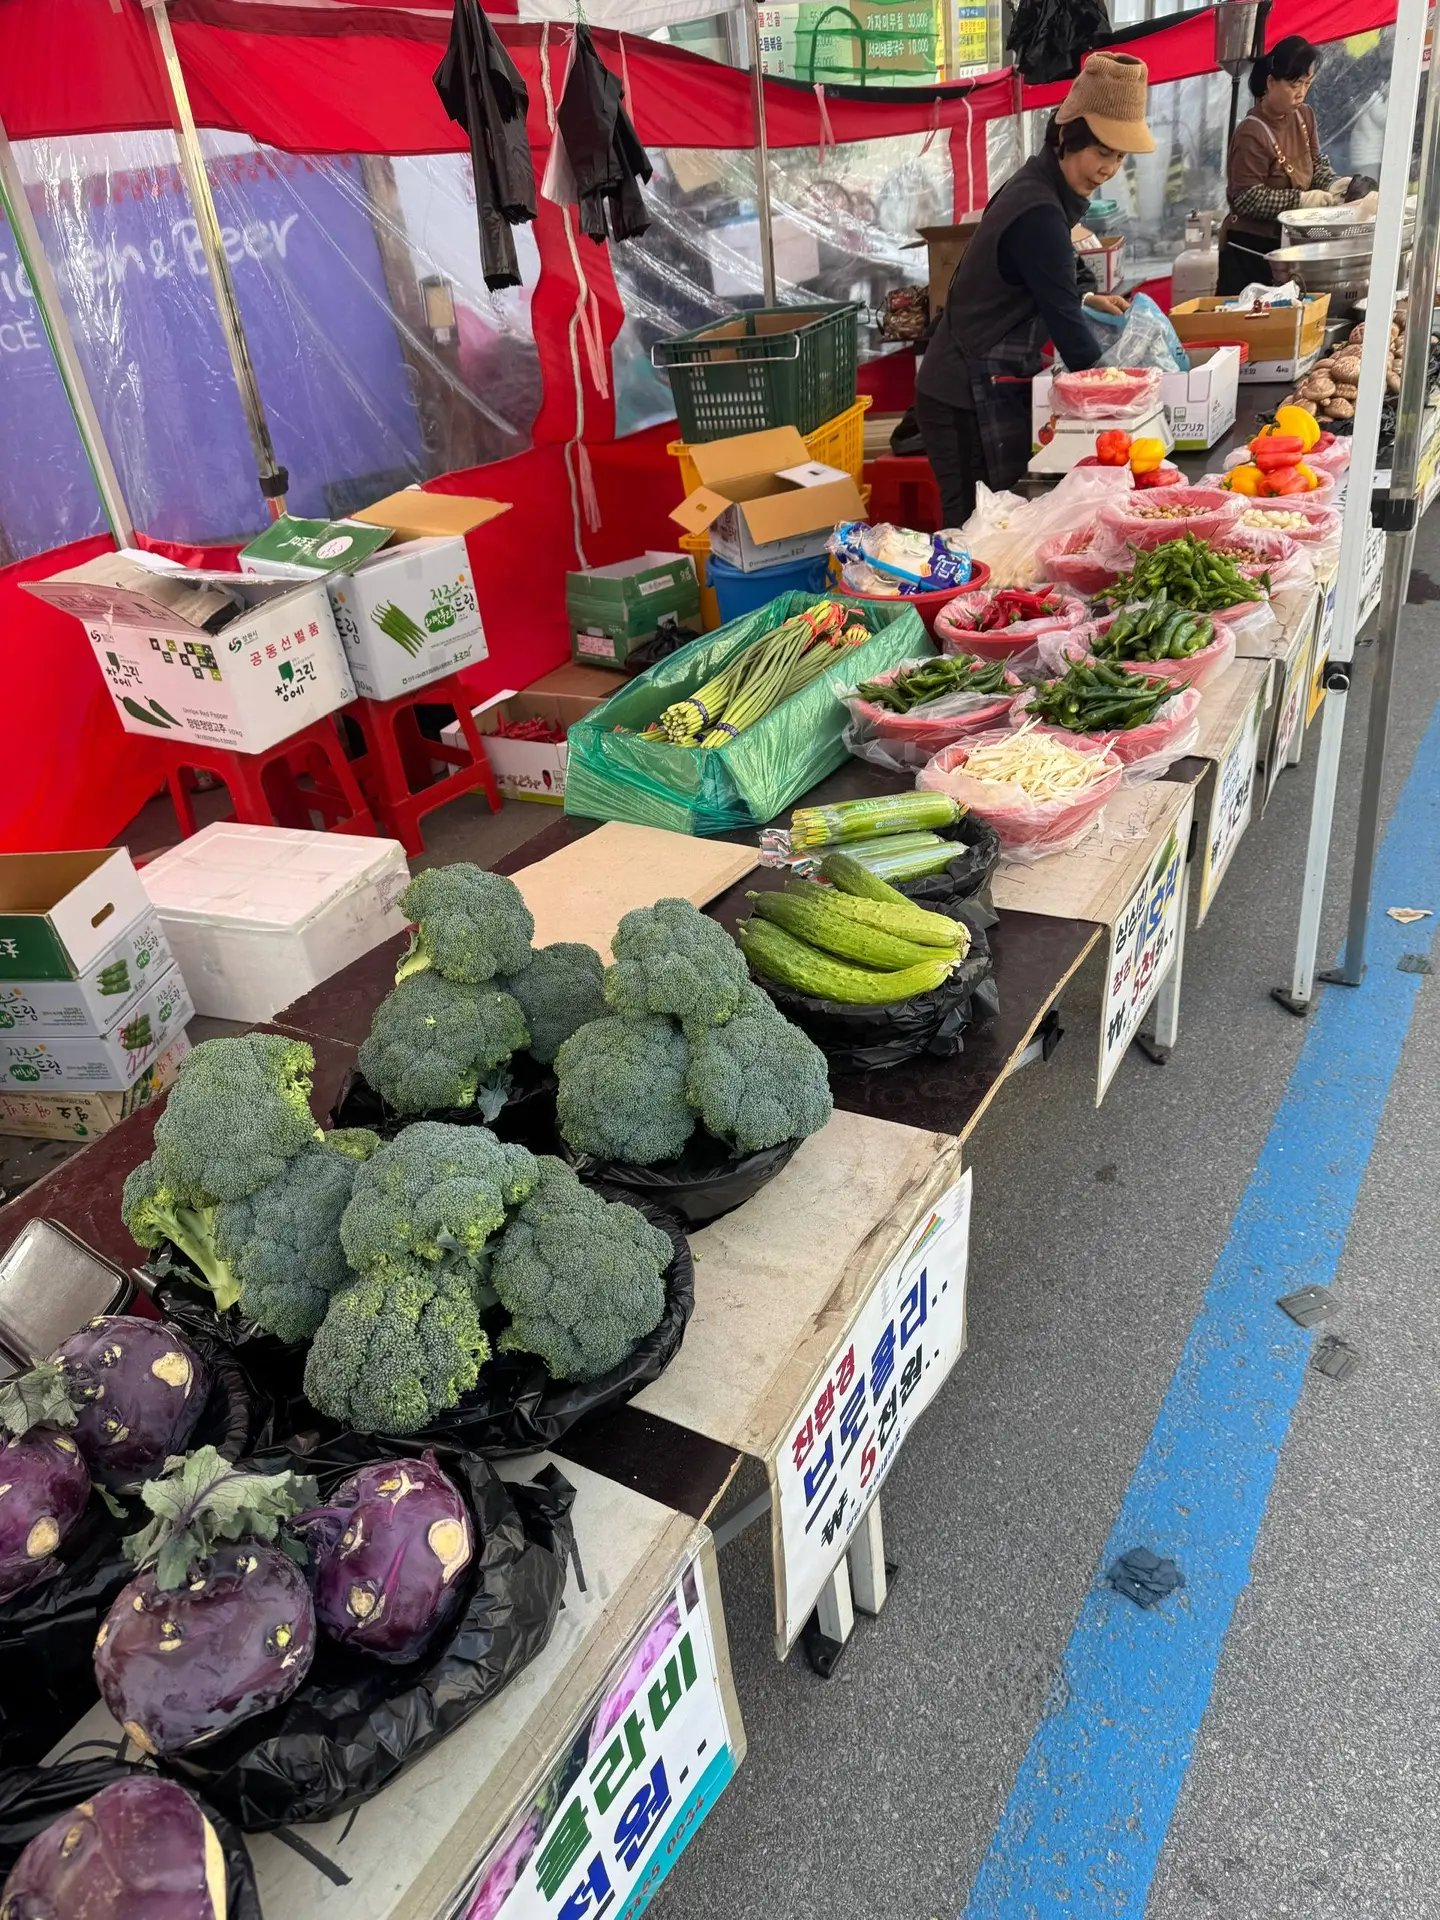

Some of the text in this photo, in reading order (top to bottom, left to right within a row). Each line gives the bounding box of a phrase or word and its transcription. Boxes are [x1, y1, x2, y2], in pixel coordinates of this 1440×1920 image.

[867, 13, 928, 31] 가자미무침 30,000
[430, 583, 463, 606] 진주
[249, 621, 319, 667] 공동선별품
[1116, 879, 1149, 955] 싱싱한
[792, 1343, 857, 1470] 친환경
[535, 1632, 698, 1903] 콜라비
